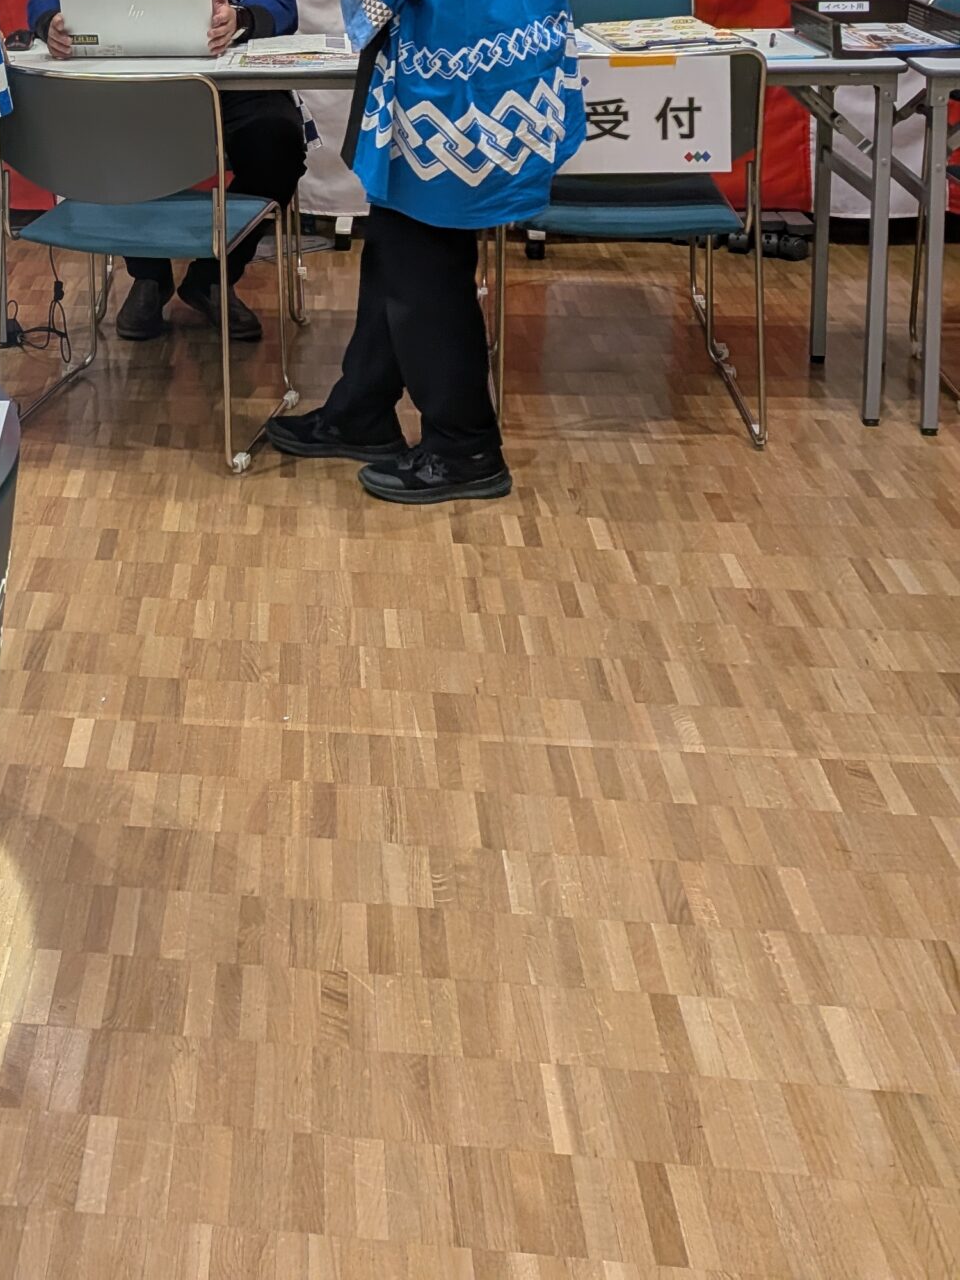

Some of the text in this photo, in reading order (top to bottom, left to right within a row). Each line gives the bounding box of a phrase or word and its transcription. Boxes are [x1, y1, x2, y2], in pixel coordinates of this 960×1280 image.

[824, 3, 865, 11] イベント用
[585, 96, 703, 142] 受付
